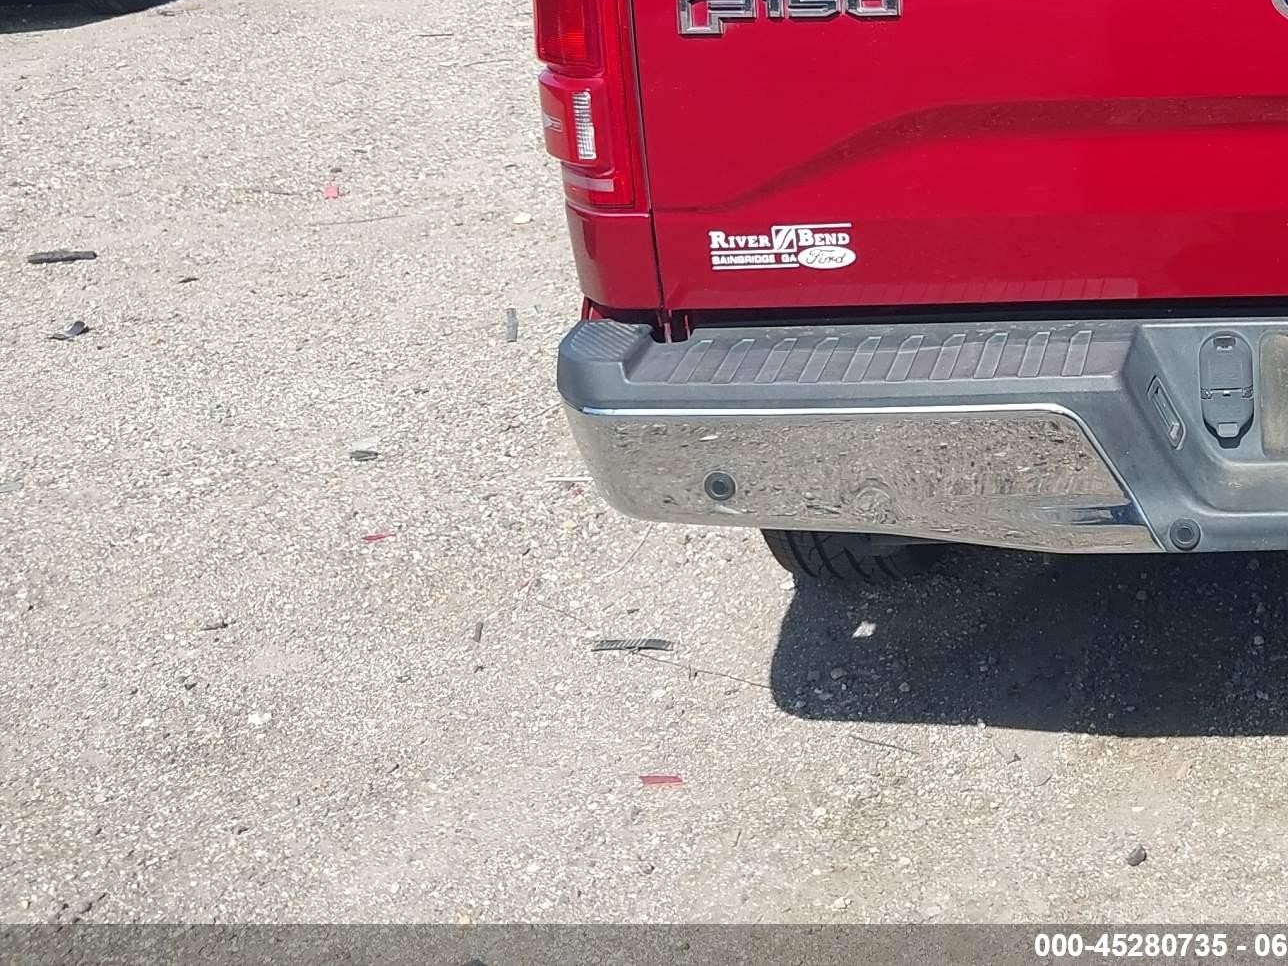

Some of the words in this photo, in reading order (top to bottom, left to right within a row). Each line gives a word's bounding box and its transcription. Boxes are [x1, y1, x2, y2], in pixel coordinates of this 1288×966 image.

[709, 231, 771, 249] RIVER
[798, 228, 850, 246] BEND
[781, 253, 798, 263] GA
[805, 249, 847, 264] Ford
